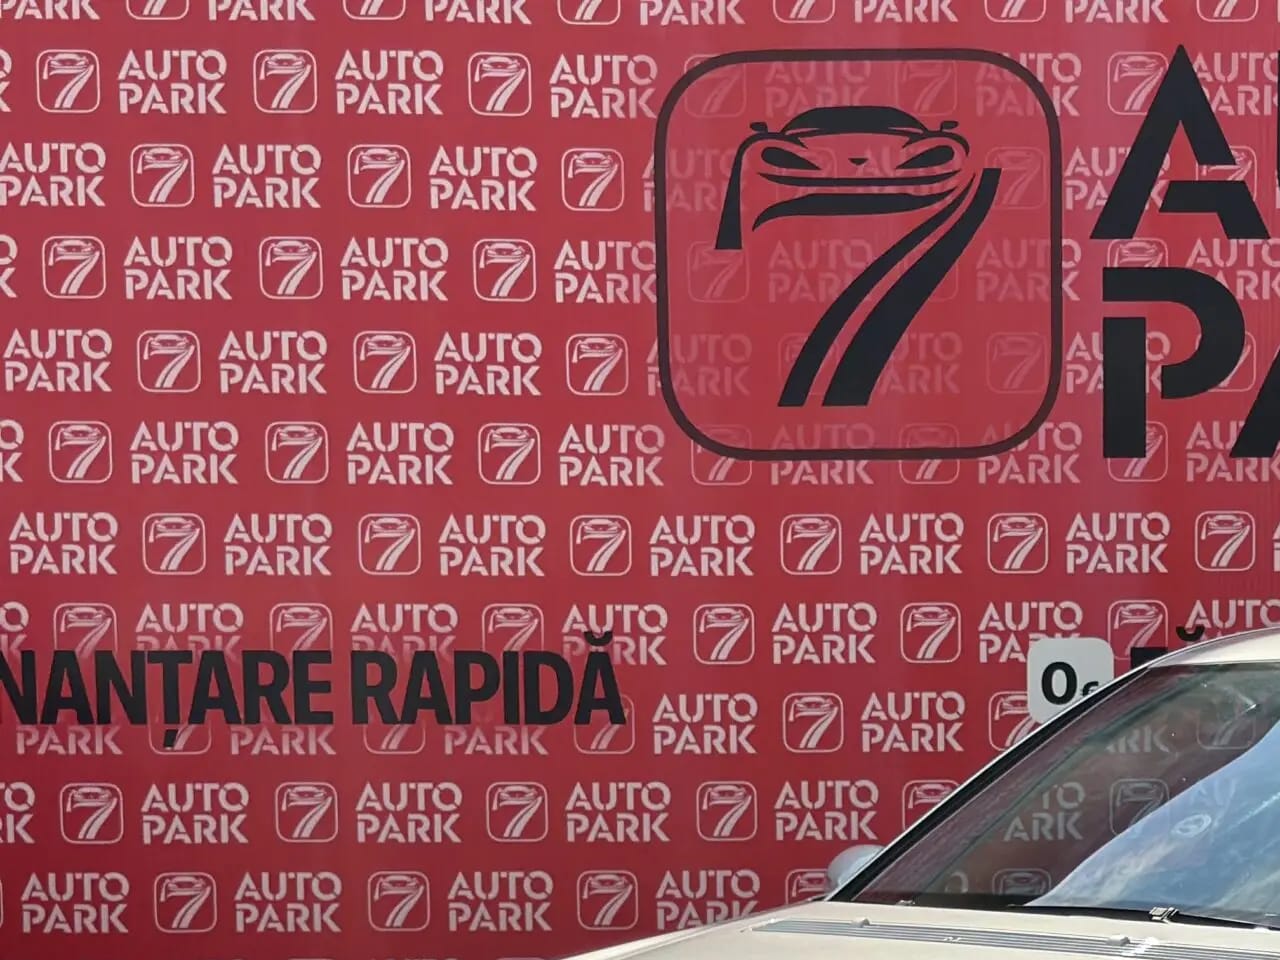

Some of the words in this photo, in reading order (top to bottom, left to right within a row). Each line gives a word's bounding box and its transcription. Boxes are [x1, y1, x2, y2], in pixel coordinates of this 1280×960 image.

[640, 0, 745, 26] PARK
[117, 49, 227, 81] AUTO
[335, 49, 443, 82] AUTO
[549, 54, 657, 85] AUTO
[119, 82, 227, 114] PARK
[336, 82, 443, 115] PARK
[550, 86, 657, 119] PARK
[0, 142, 106, 174] AUTO
[212, 144, 321, 175] AUTO
[428, 145, 537, 178] AUTO
[0, 174, 105, 207] PARK
[213, 176, 321, 208] PARK
[430, 177, 536, 211] PARK
[123, 236, 232, 267] AUTO
[340, 236, 448, 269] AUTO
[553, 240, 656, 272] AUTO
[125, 269, 232, 300] PARK
[342, 269, 448, 301] PARK
[555, 272, 657, 303] PARK
[3, 328, 112, 359] AUTO
[218, 330, 327, 362] AUTO
[434, 332, 542, 364] AUTO
[5, 360, 112, 392] PARK
[220, 362, 327, 394] PARK
[435, 363, 541, 396] PARK
[130, 421, 239, 452] AUTO
[346, 422, 454, 453] AUTO
[558, 424, 664, 454] AUTO
[131, 453, 238, 484] PARK
[347, 453, 453, 485] PARK
[560, 455, 664, 486] PARK
[978, 454, 1080, 483] PARK
[9, 512, 118, 542] AUTO
[224, 513, 332, 544] AUTO
[438, 514, 546, 545] AUTO
[648, 514, 755, 545] AUTO
[859, 512, 964, 543] AUTO
[1065, 512, 1170, 542] AUTO
[10, 544, 117, 575] PARK
[225, 545, 331, 576] PARK
[440, 546, 544, 576] PARK
[650, 546, 754, 576] PARK
[860, 544, 962, 575] PARK
[1067, 543, 1168, 574] PARK
[135, 603, 243, 632] AUTO
[350, 603, 458, 633] AUTO
[562, 603, 668, 633] AUTO
[772, 602, 877, 632] AUTO
[978, 601, 1083, 631] AUTO
[773, 634, 876, 664] PARK
[351, 631, 626, 724] RAPIDĂ
[652, 693, 758, 723] AUTO
[861, 691, 965, 721] AUTO
[17, 725, 122, 755] PARK
[231, 725, 338, 755] PARK
[445, 725, 548, 755] PARK
[653, 724, 757, 754] PARK
[862, 722, 964, 752] PARK
[141, 782, 249, 813] AUTO
[355, 782, 462, 811] AUTO
[565, 781, 671, 811] AUTO
[774, 779, 879, 810] AUTO
[142, 813, 248, 844] PARK
[357, 813, 461, 843] PARK
[566, 812, 670, 842] PARK
[776, 811, 878, 840] PARK
[21, 872, 130, 902] AUTO
[234, 872, 342, 901] AUTO
[448, 870, 553, 900] AUTO
[656, 869, 760, 899] AUTO
[22, 903, 128, 933] PARK
[235, 903, 341, 932] PARK
[448, 901, 552, 931] PARK
